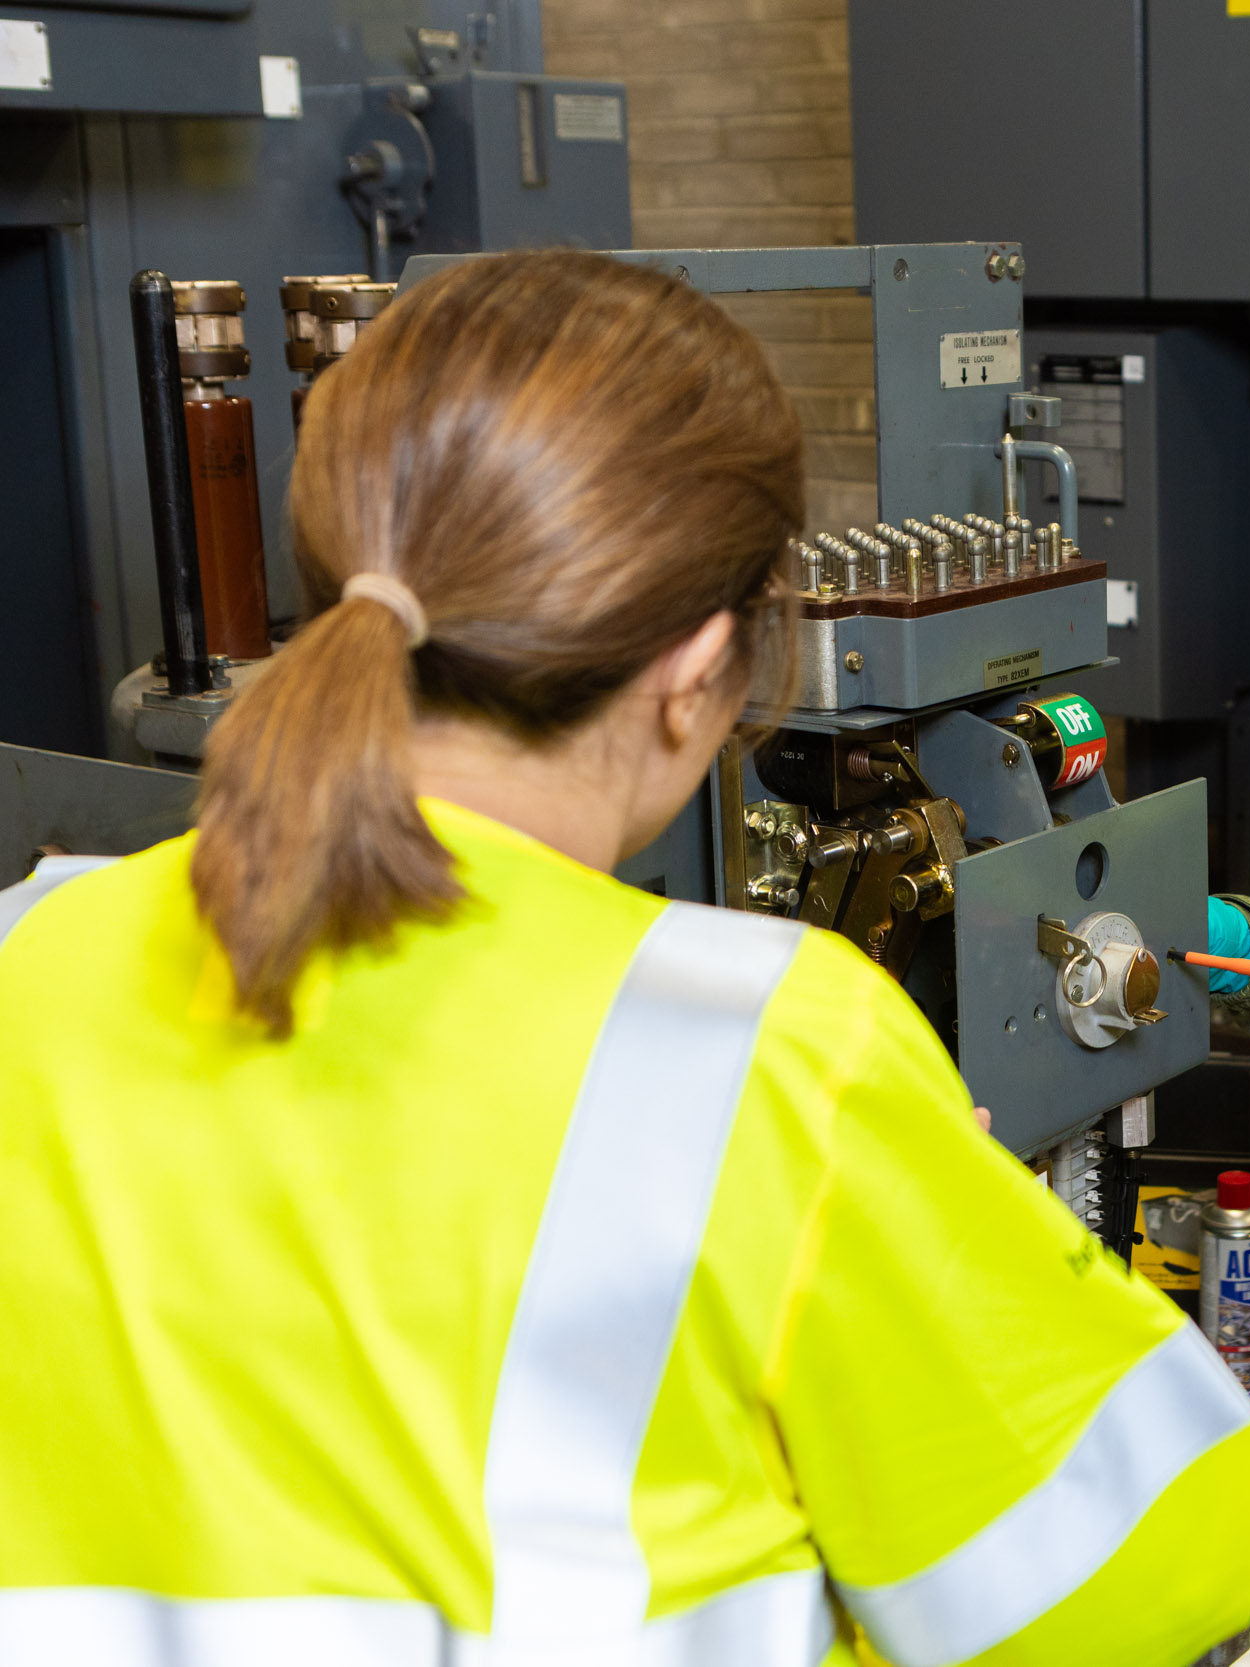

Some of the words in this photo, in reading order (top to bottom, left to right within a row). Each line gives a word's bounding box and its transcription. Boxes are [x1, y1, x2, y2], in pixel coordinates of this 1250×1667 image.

[954, 336, 978, 348] ISOLATING
[981, 335, 1007, 346] MECHANISM
[958, 356, 970, 364] FREE
[974, 355, 994, 363] LOCKED
[988, 658, 1011, 670] OPERATING
[1013, 650, 1039, 664] MECHANISM
[997, 674, 1009, 684] TYPE
[1056, 703, 1092, 735] OFF
[1065, 750, 1100, 784] ON
